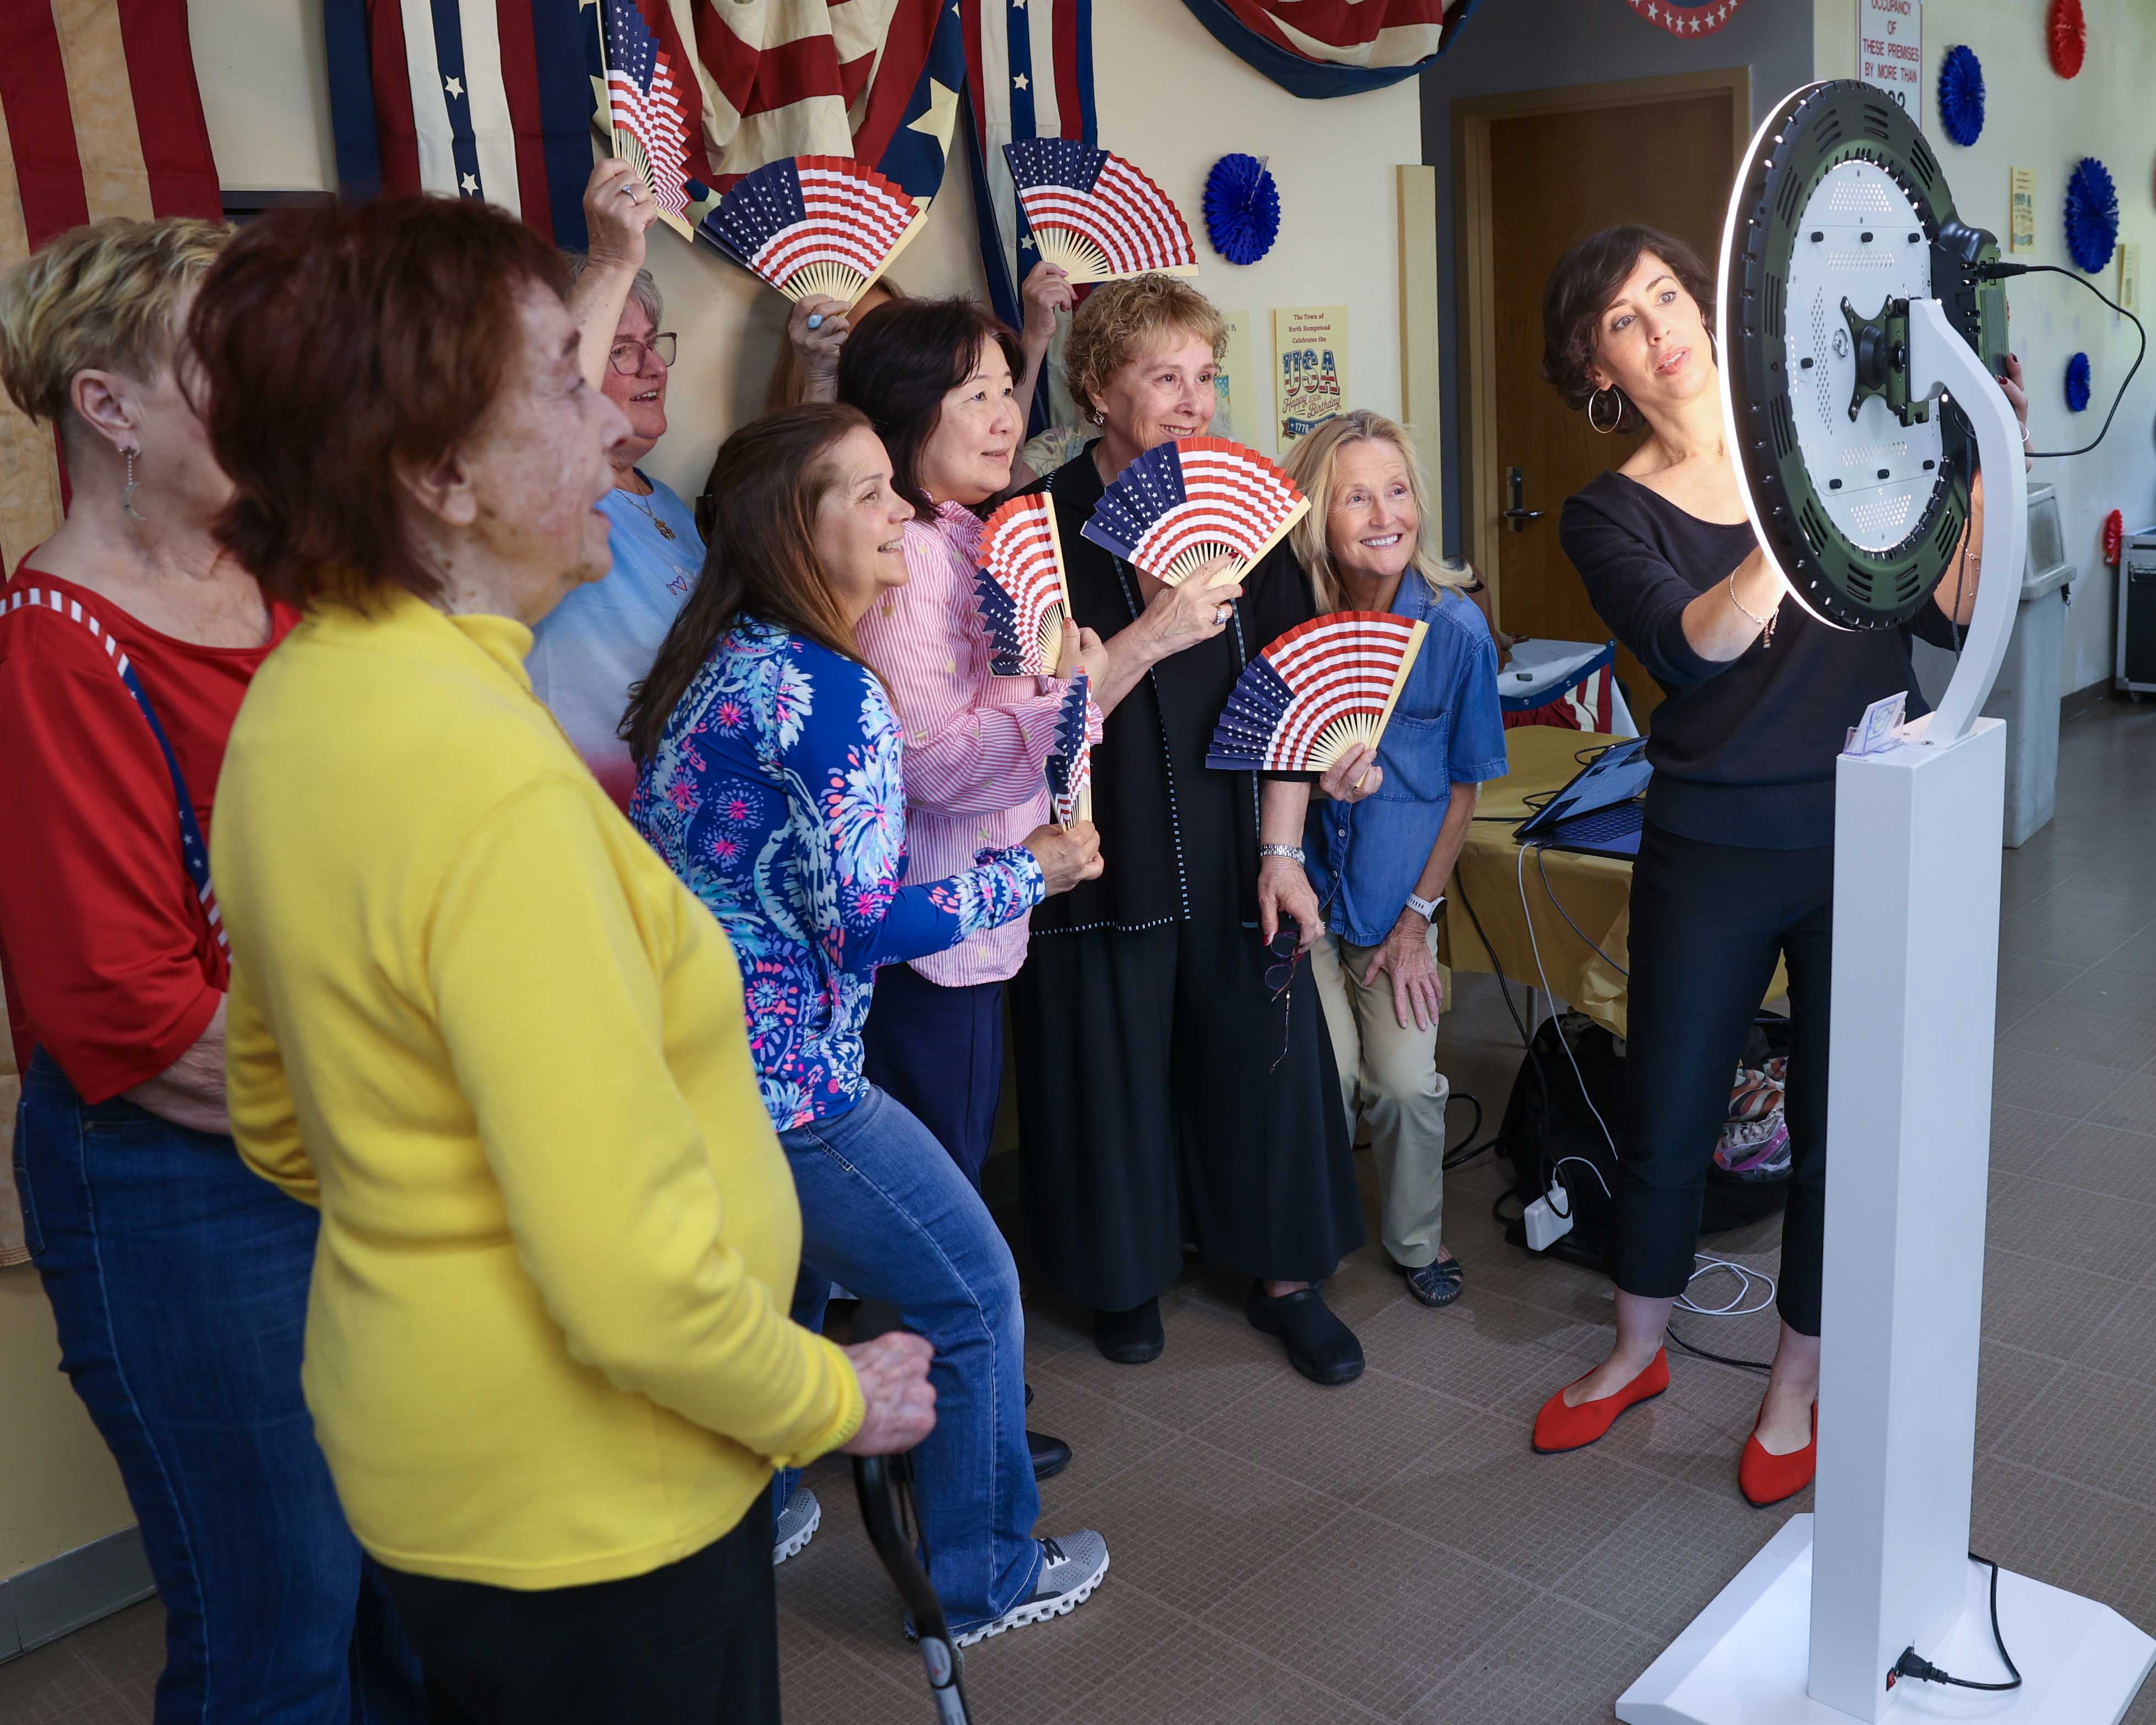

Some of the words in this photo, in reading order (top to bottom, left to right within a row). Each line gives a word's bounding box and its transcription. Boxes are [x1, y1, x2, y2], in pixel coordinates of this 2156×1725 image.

[1871, 0, 1911, 15] OCCUPANCY
[1887, 20, 1897, 35] OF
[1863, 38, 1885, 56] THESE
[1888, 42, 1919, 62] PREMISES
[1865, 61, 1874, 77] BY
[1877, 63, 1897, 80] MORE
[1900, 67, 1918, 83] THAN
[1303, 324, 1330, 332] Hempstead
[1282, 349, 1340, 396] USA
[1282, 394, 1308, 413] Happy
[1307, 396, 1341, 418] Birthday
